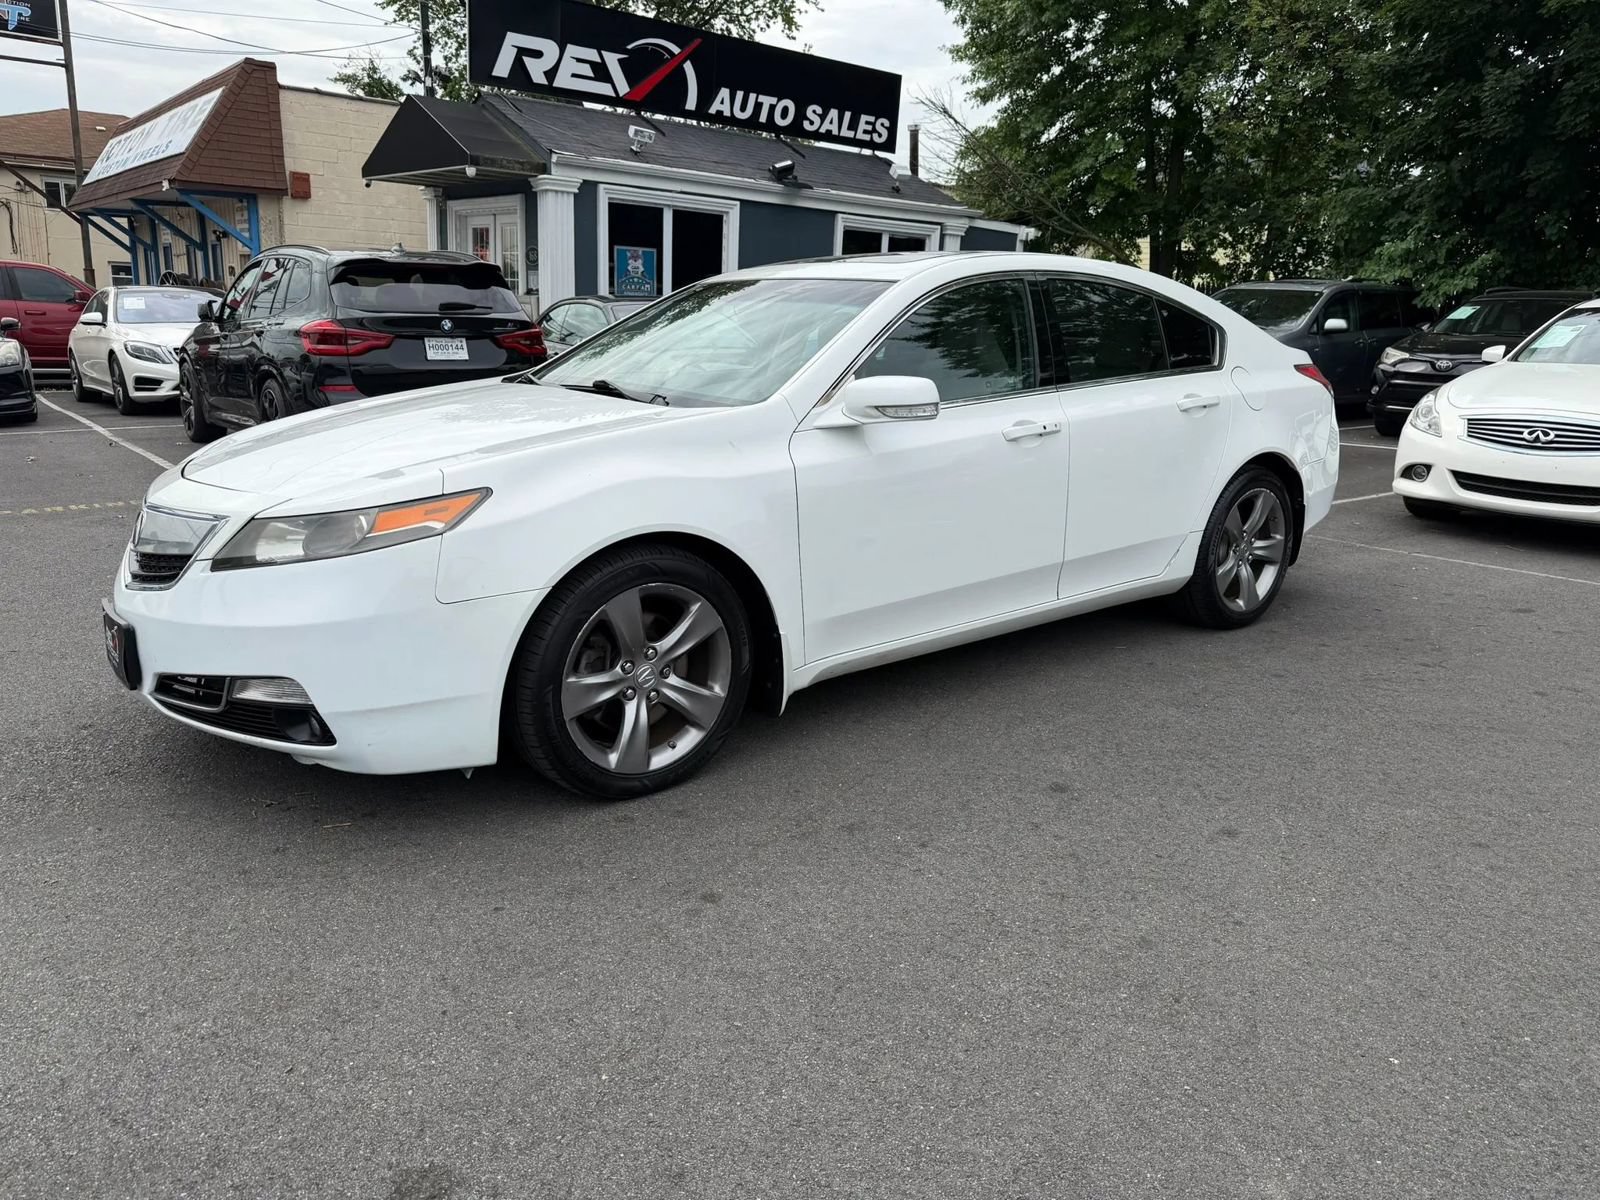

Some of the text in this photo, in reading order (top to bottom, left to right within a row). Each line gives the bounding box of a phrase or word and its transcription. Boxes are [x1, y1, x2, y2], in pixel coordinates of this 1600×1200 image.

[491, 31, 703, 102] REX
[708, 87, 890, 144] AUTO SALES
[427, 343, 465, 351] H000144
